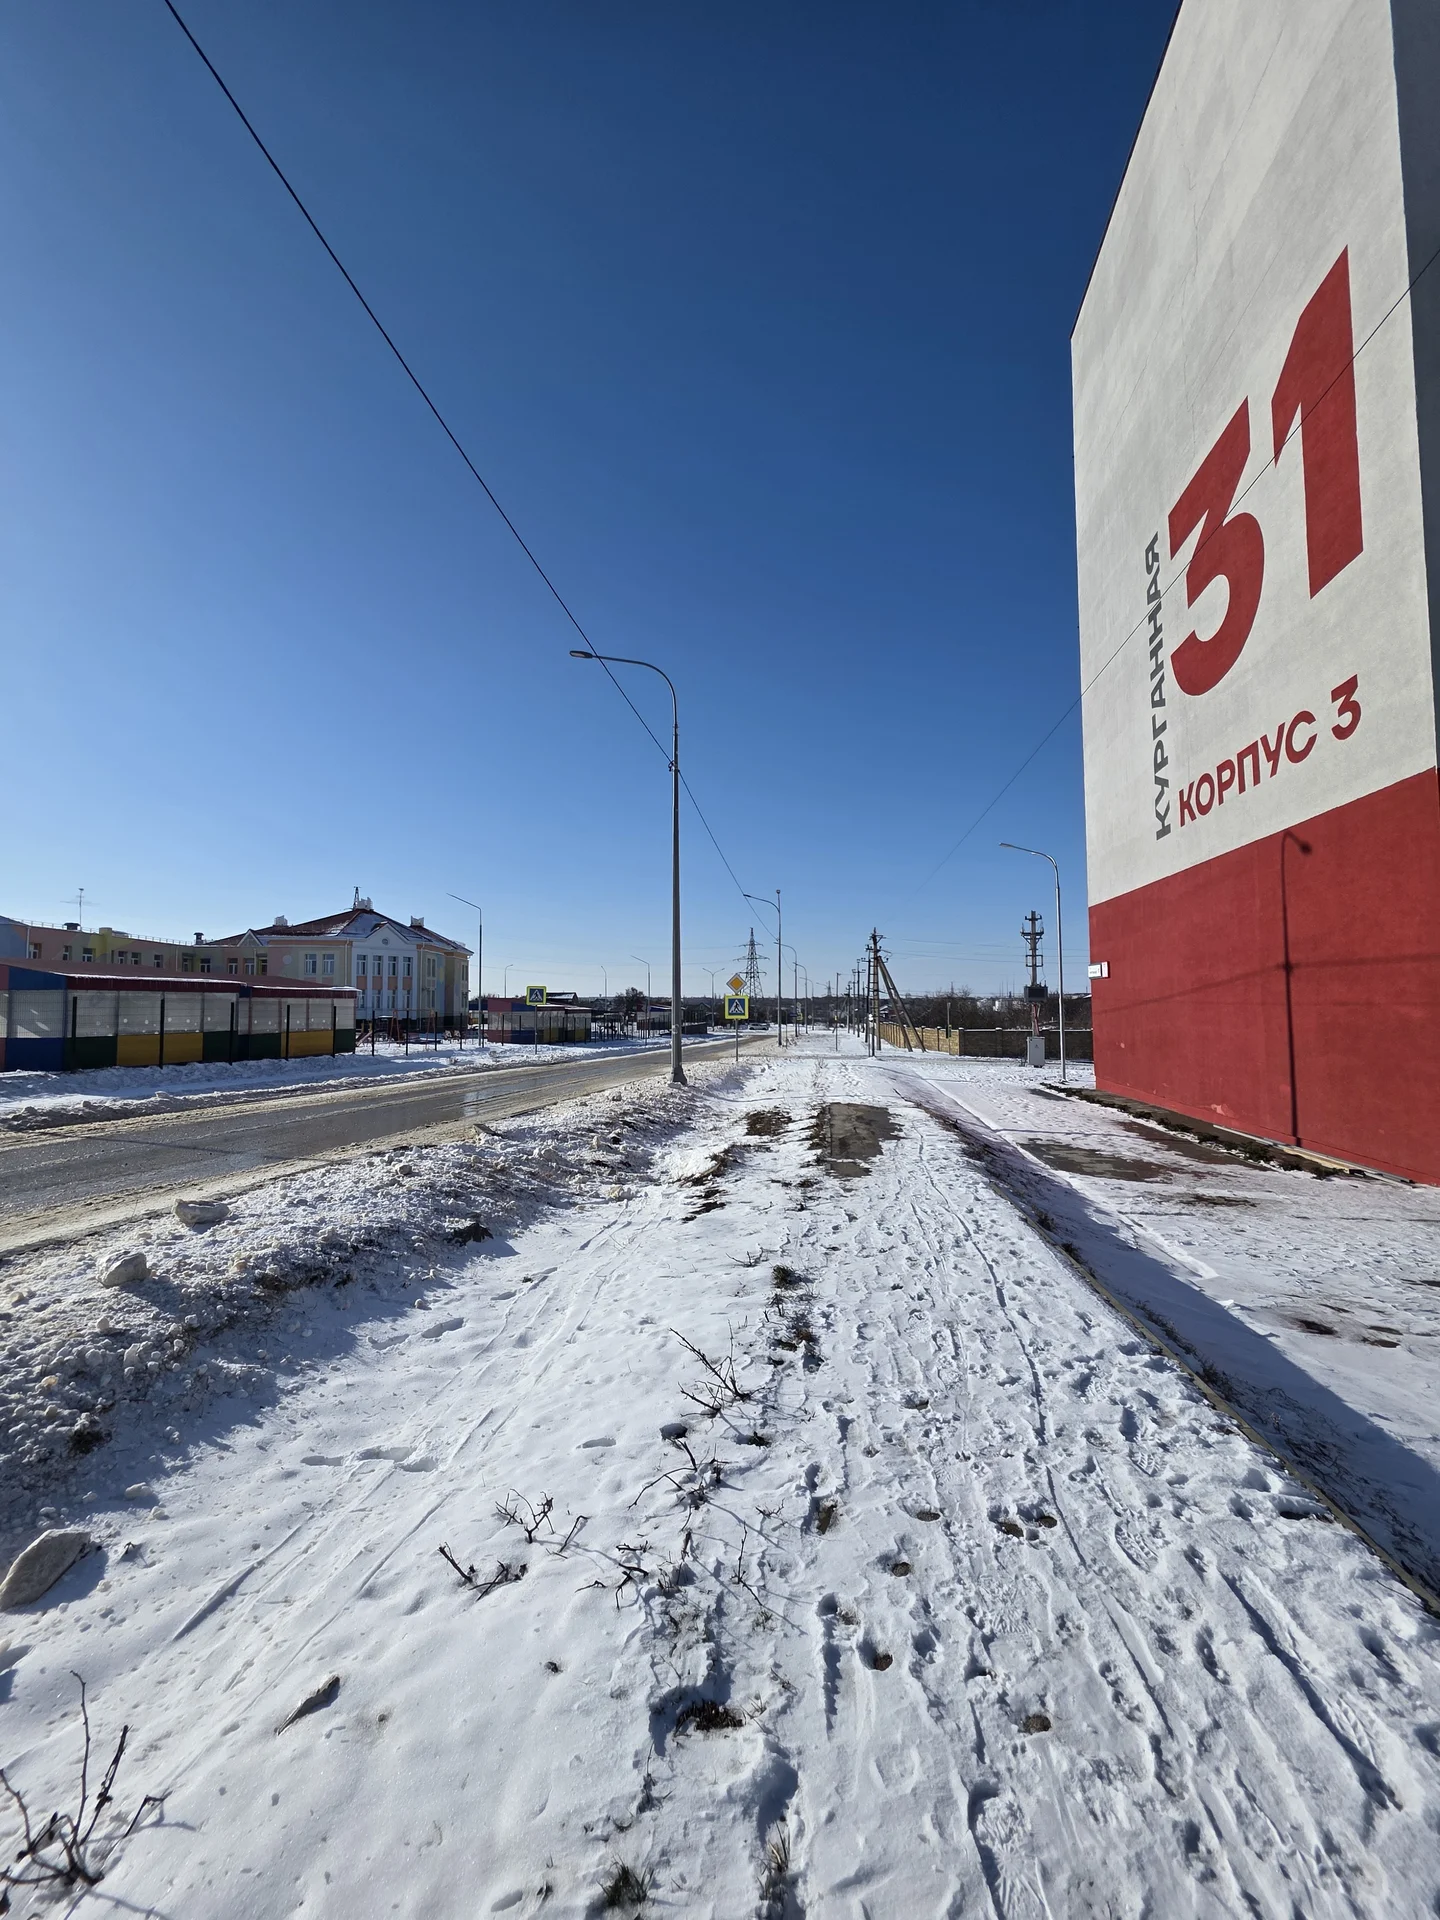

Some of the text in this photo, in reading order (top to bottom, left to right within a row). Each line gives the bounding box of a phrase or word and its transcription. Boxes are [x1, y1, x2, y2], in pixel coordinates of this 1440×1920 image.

[1168, 246, 1363, 696] 31
[1144, 531, 1171, 841] КУРГАННАЯ
[1179, 674, 1361, 827] КОРПУС 3
